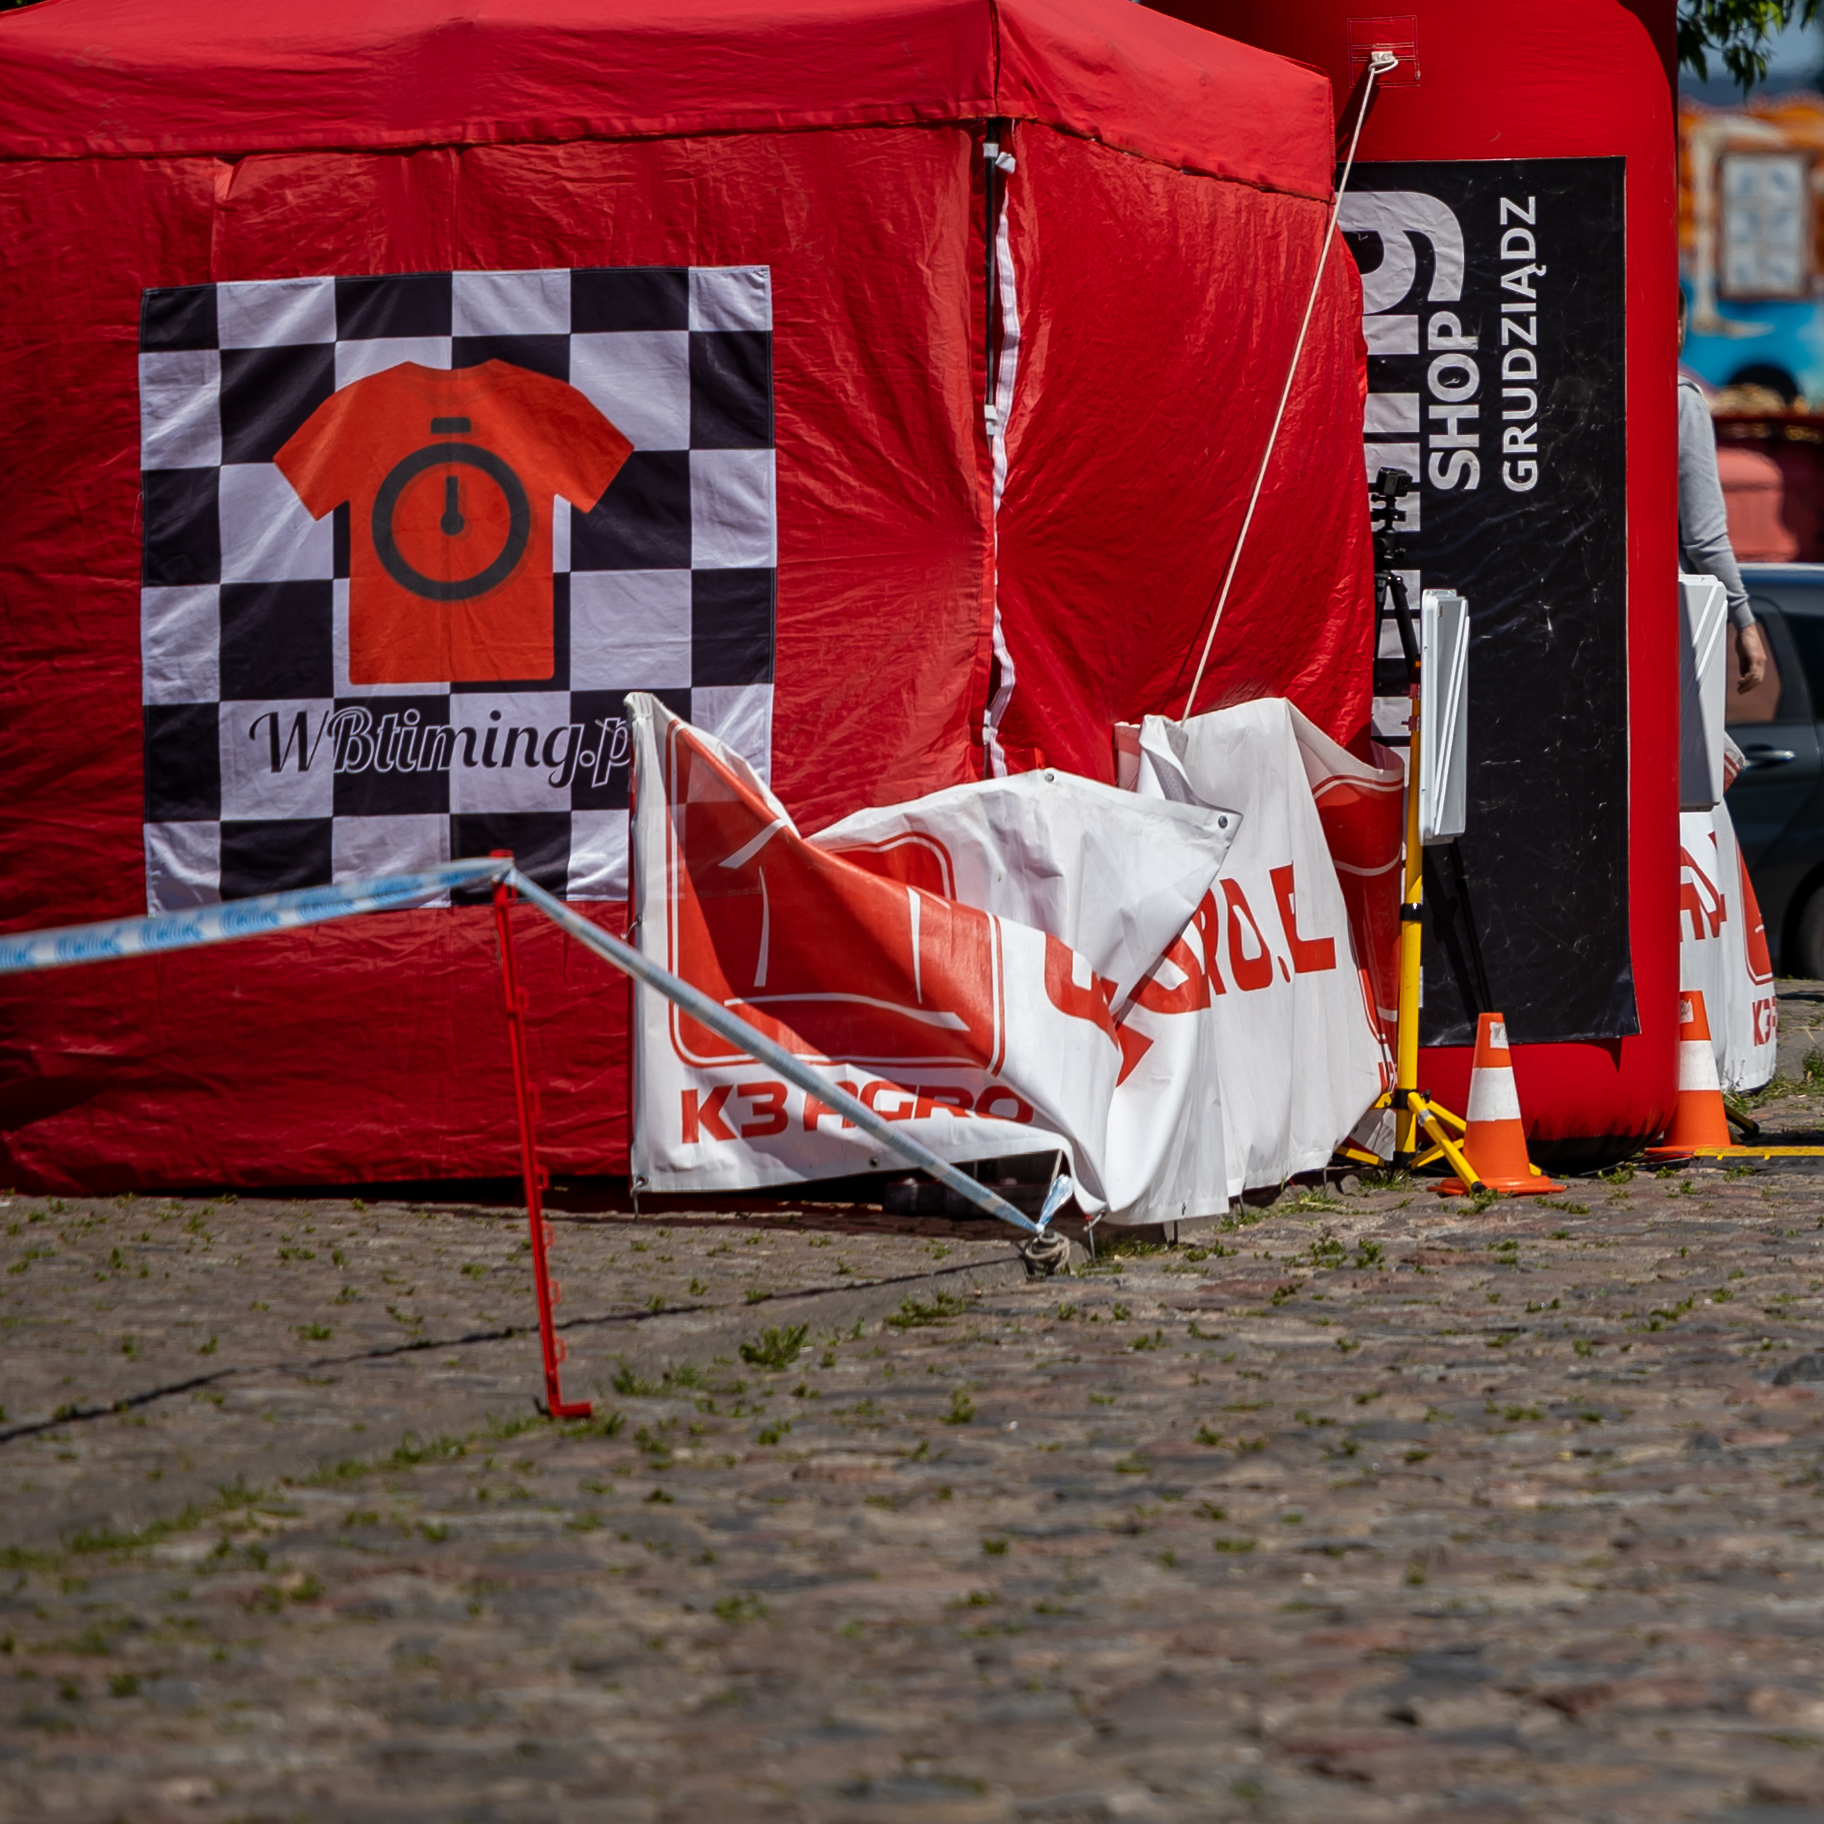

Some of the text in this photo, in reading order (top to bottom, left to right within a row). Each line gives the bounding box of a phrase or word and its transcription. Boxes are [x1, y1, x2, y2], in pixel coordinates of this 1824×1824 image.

[1428, 310, 1481, 492] SHOP
[1498, 195, 1548, 492] GRUDZIĄDZ
[248, 706, 632, 789] WBtiming.p
[680, 1079, 1034, 1145] K3 AGRO
